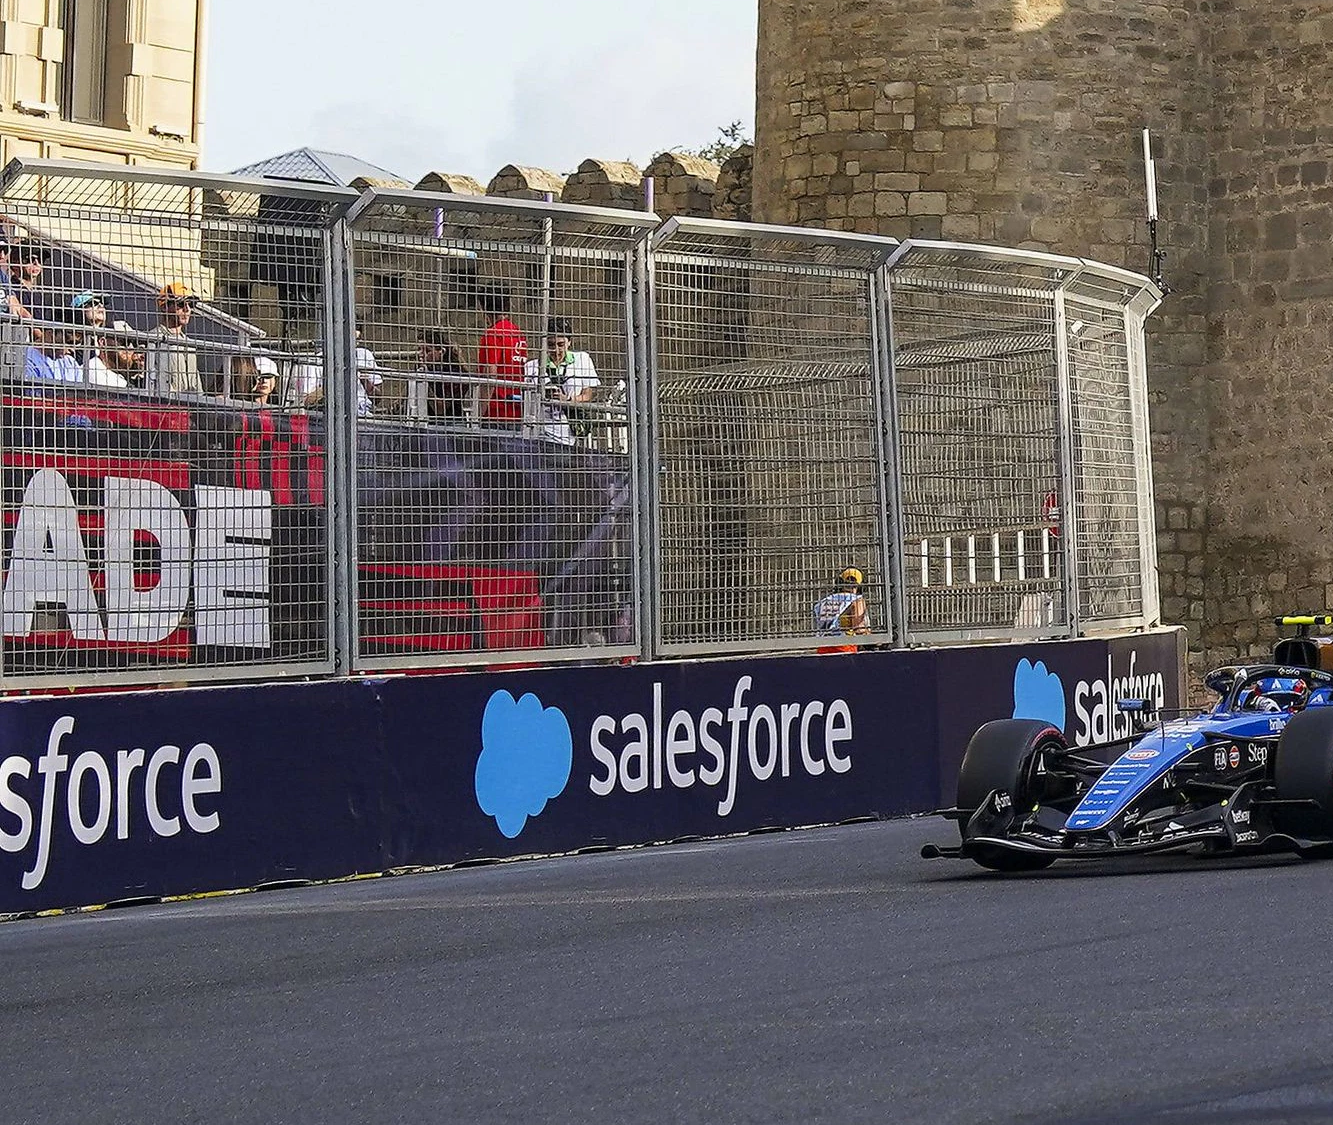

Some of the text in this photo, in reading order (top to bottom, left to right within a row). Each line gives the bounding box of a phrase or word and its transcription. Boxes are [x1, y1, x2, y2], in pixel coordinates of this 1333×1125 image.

[2, 468, 272, 648] ADE
[0, 716, 222, 890] sforce
[589, 675, 853, 816] salesforce
